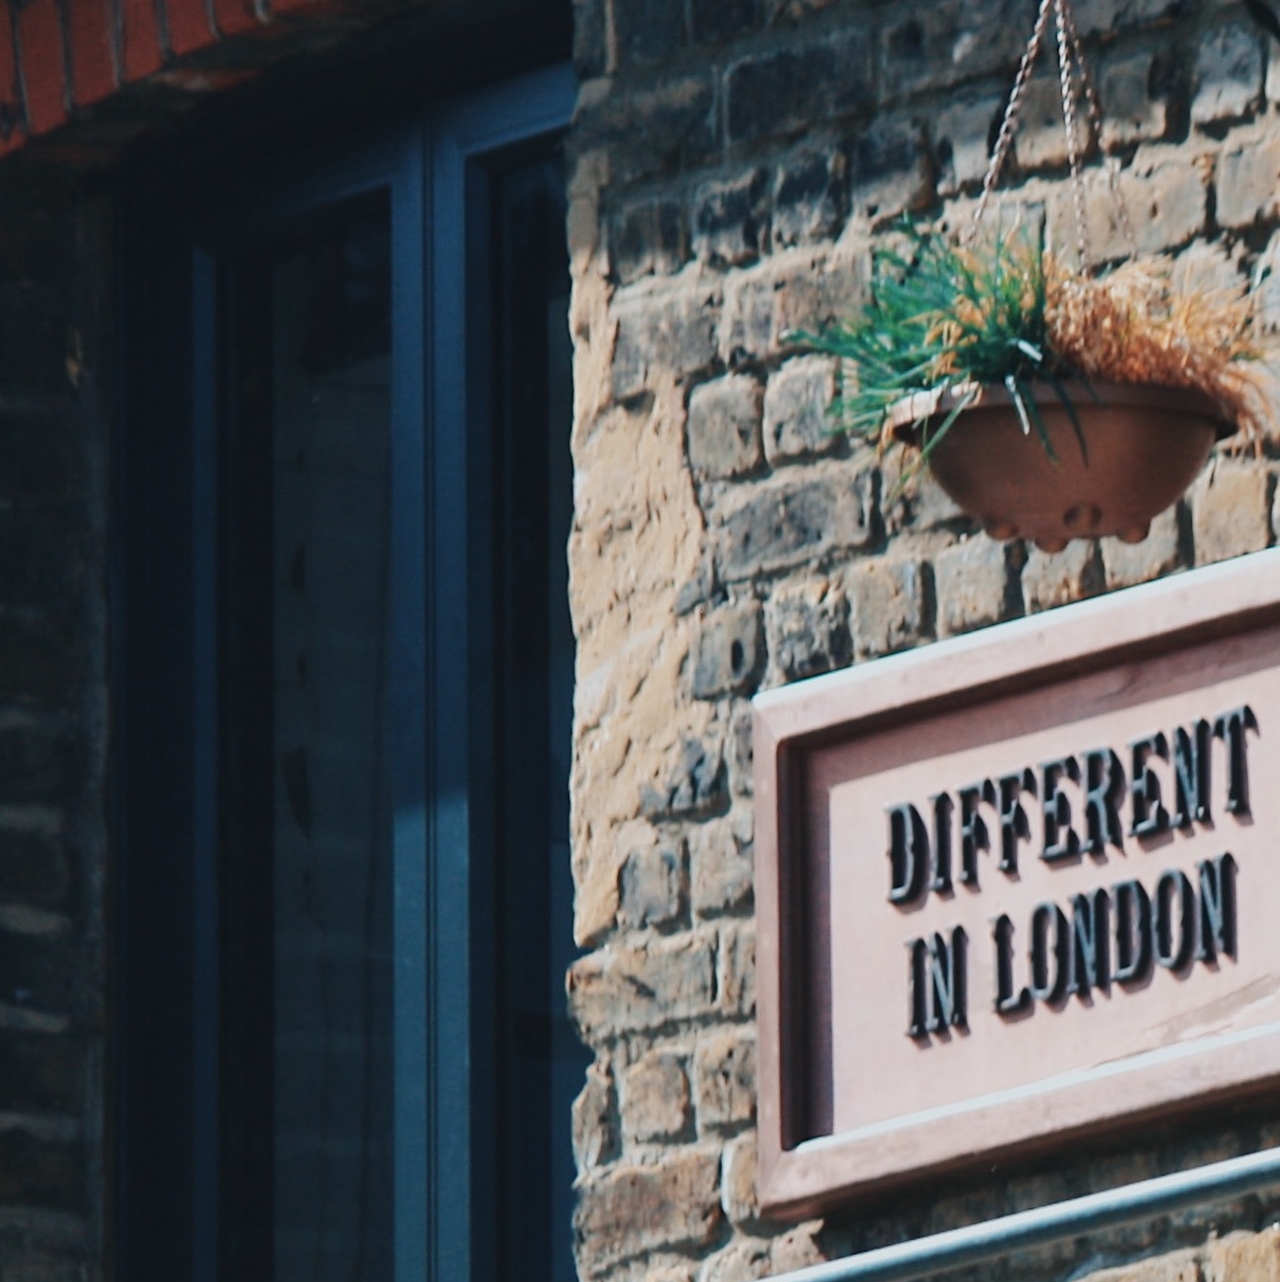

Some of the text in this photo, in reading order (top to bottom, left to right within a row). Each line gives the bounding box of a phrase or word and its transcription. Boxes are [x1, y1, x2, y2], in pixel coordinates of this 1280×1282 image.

[884, 704, 1257, 906] DIFFERENT
[904, 851, 1238, 1040] IN LONDON
